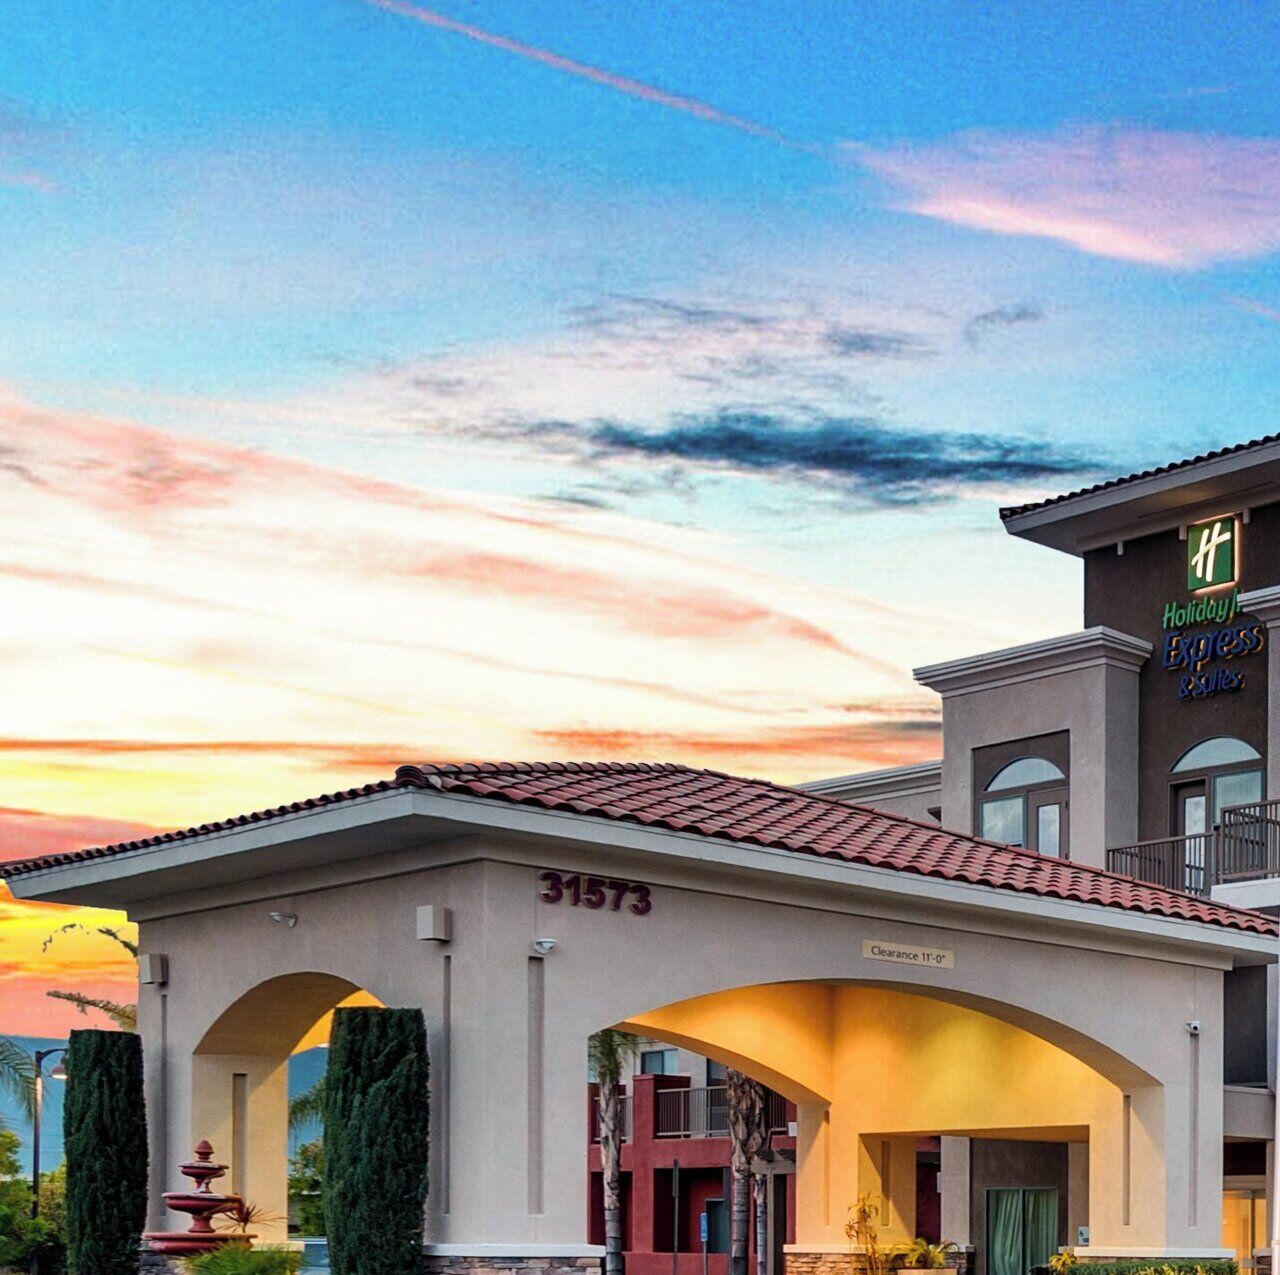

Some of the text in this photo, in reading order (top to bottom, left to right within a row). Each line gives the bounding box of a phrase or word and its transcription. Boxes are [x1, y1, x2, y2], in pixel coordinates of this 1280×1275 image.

[1162, 593, 1230, 630] Holiday
[1162, 621, 1265, 673] Express
[1194, 669, 1246, 694] Suites
[539, 871, 652, 916] 31573
[871, 945, 919, 961] Clearance
